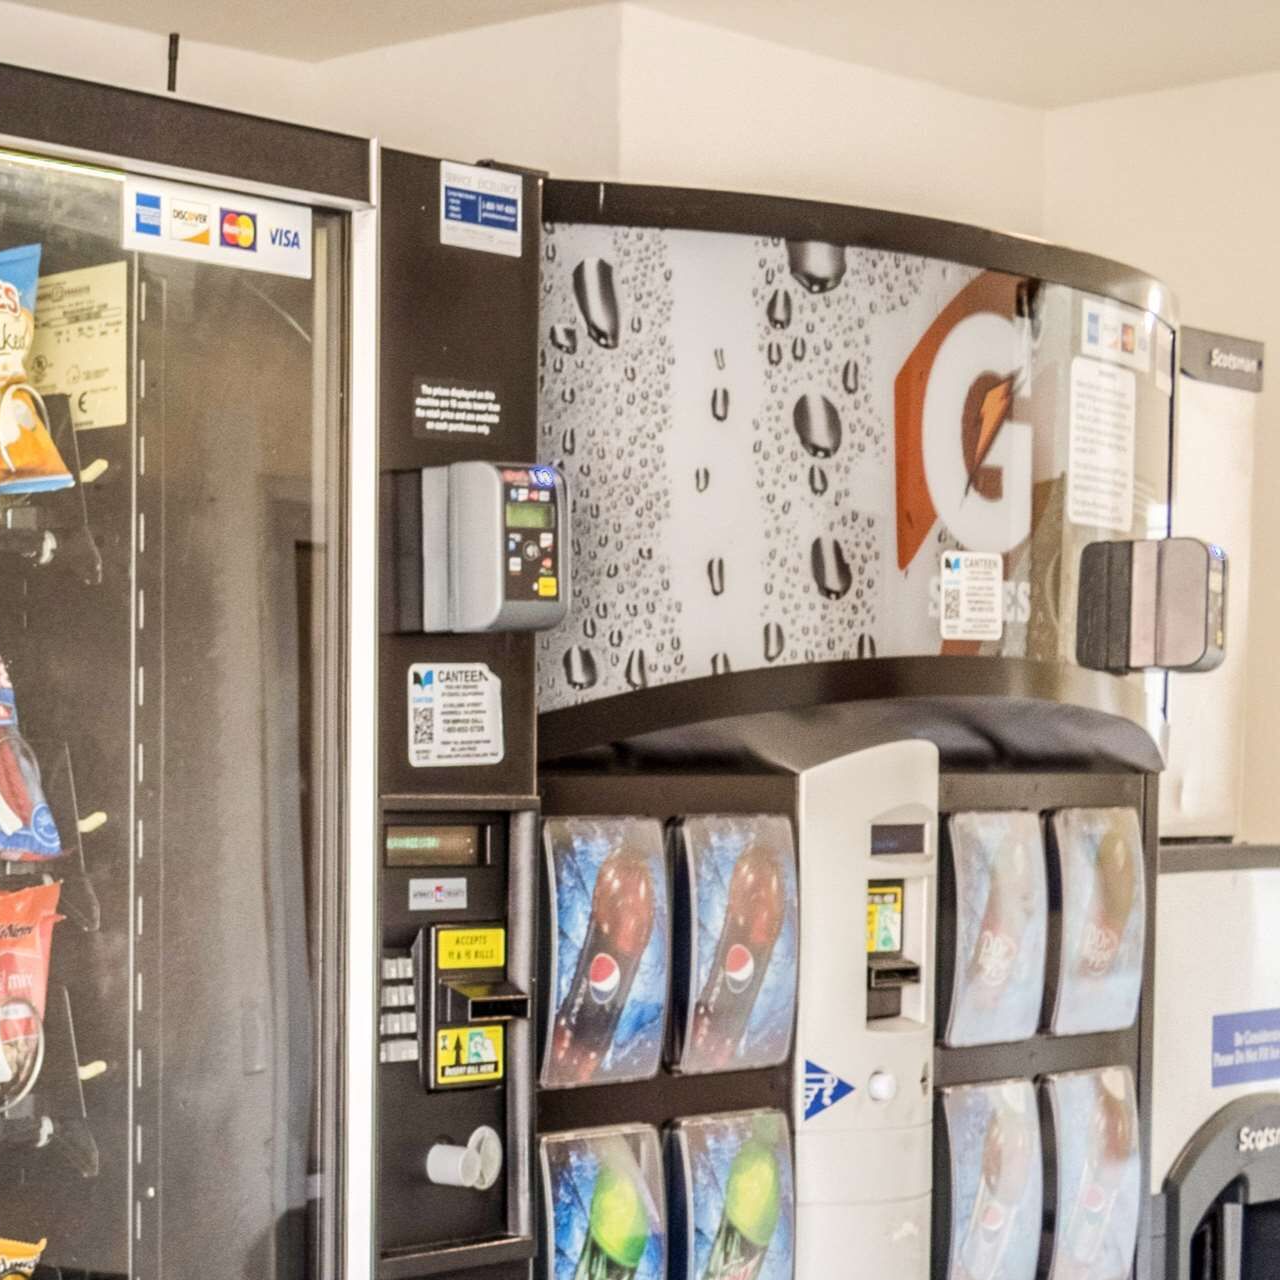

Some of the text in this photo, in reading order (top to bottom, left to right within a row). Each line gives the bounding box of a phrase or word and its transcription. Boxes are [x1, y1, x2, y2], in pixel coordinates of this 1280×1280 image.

[173, 209, 207, 223] DISCOVER
[270, 228, 300, 249] VISA
[922, 311, 1032, 552] G
